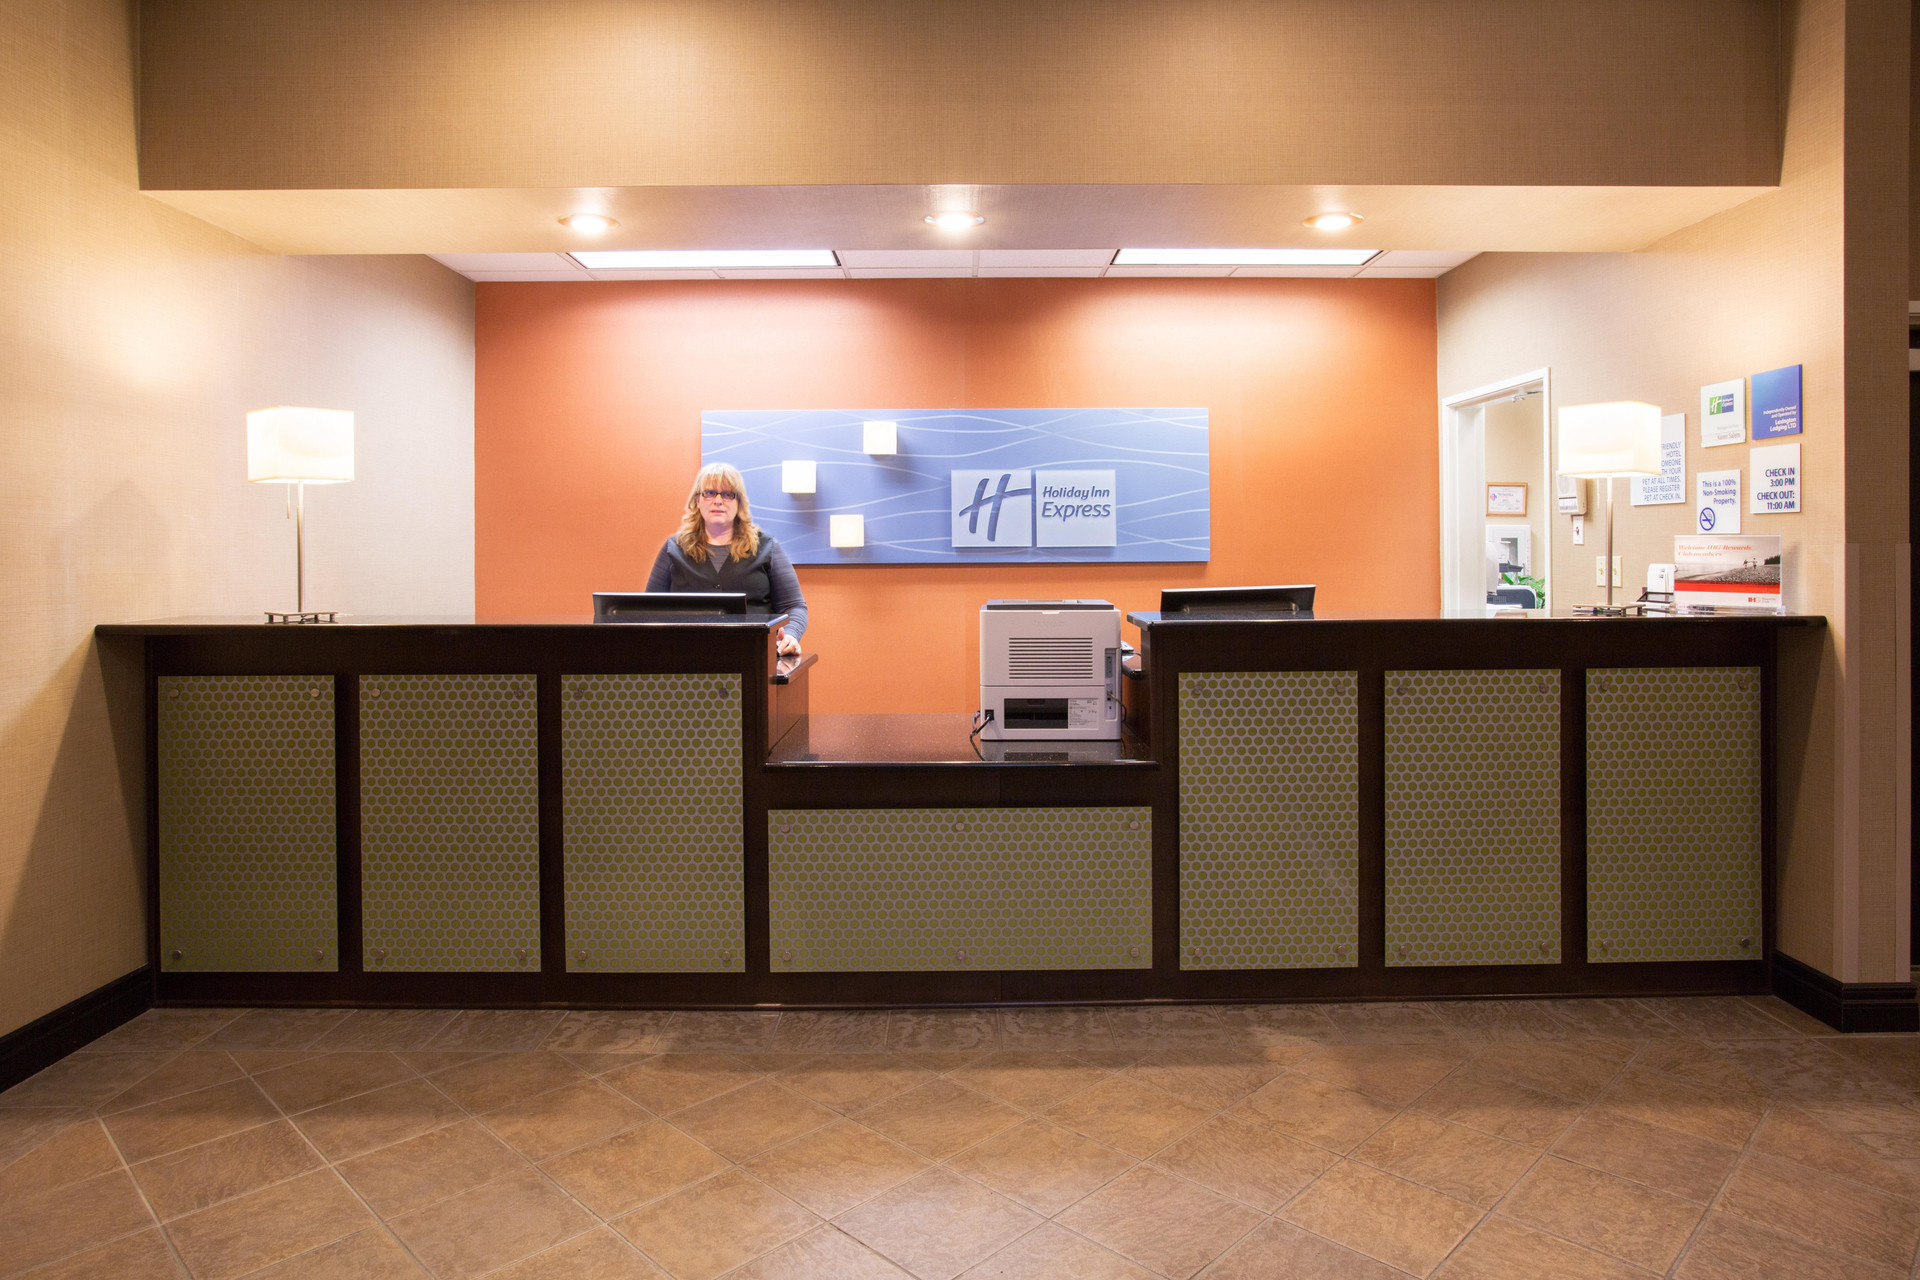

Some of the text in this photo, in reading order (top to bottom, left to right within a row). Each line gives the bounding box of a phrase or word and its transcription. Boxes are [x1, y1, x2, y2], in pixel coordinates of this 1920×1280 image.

[1775, 417, 1797, 425] Lexington
[1770, 424, 1787, 432] Lodging
[1661, 442, 1681, 451] RIENDLY
[1666, 450, 1681, 458] HOTEL
[1661, 459, 1681, 467] OMEONE
[1668, 467, 1682, 475] YOUR
[1765, 467, 1795, 477] CHECK IN
[1642, 477, 1651, 485] PET
[1657, 476, 1665, 484] ALL
[1770, 477, 1795, 487] 3:00 PM
[1042, 486, 1110, 501] Holiday Inn
[1643, 484, 1680, 494] PLEASE REGISTER
[1702, 488, 1736, 496] Non-Smoking
[1644, 494, 1652, 502] PET
[1653, 493, 1659, 501] AT
[1659, 493, 1674, 501] CHECK
[1757, 490, 1795, 500] CHECK OUT:
[1713, 497, 1736, 505] Property.
[1767, 500, 1795, 510] 11:00 AM
[1042, 501, 1111, 522] Express
